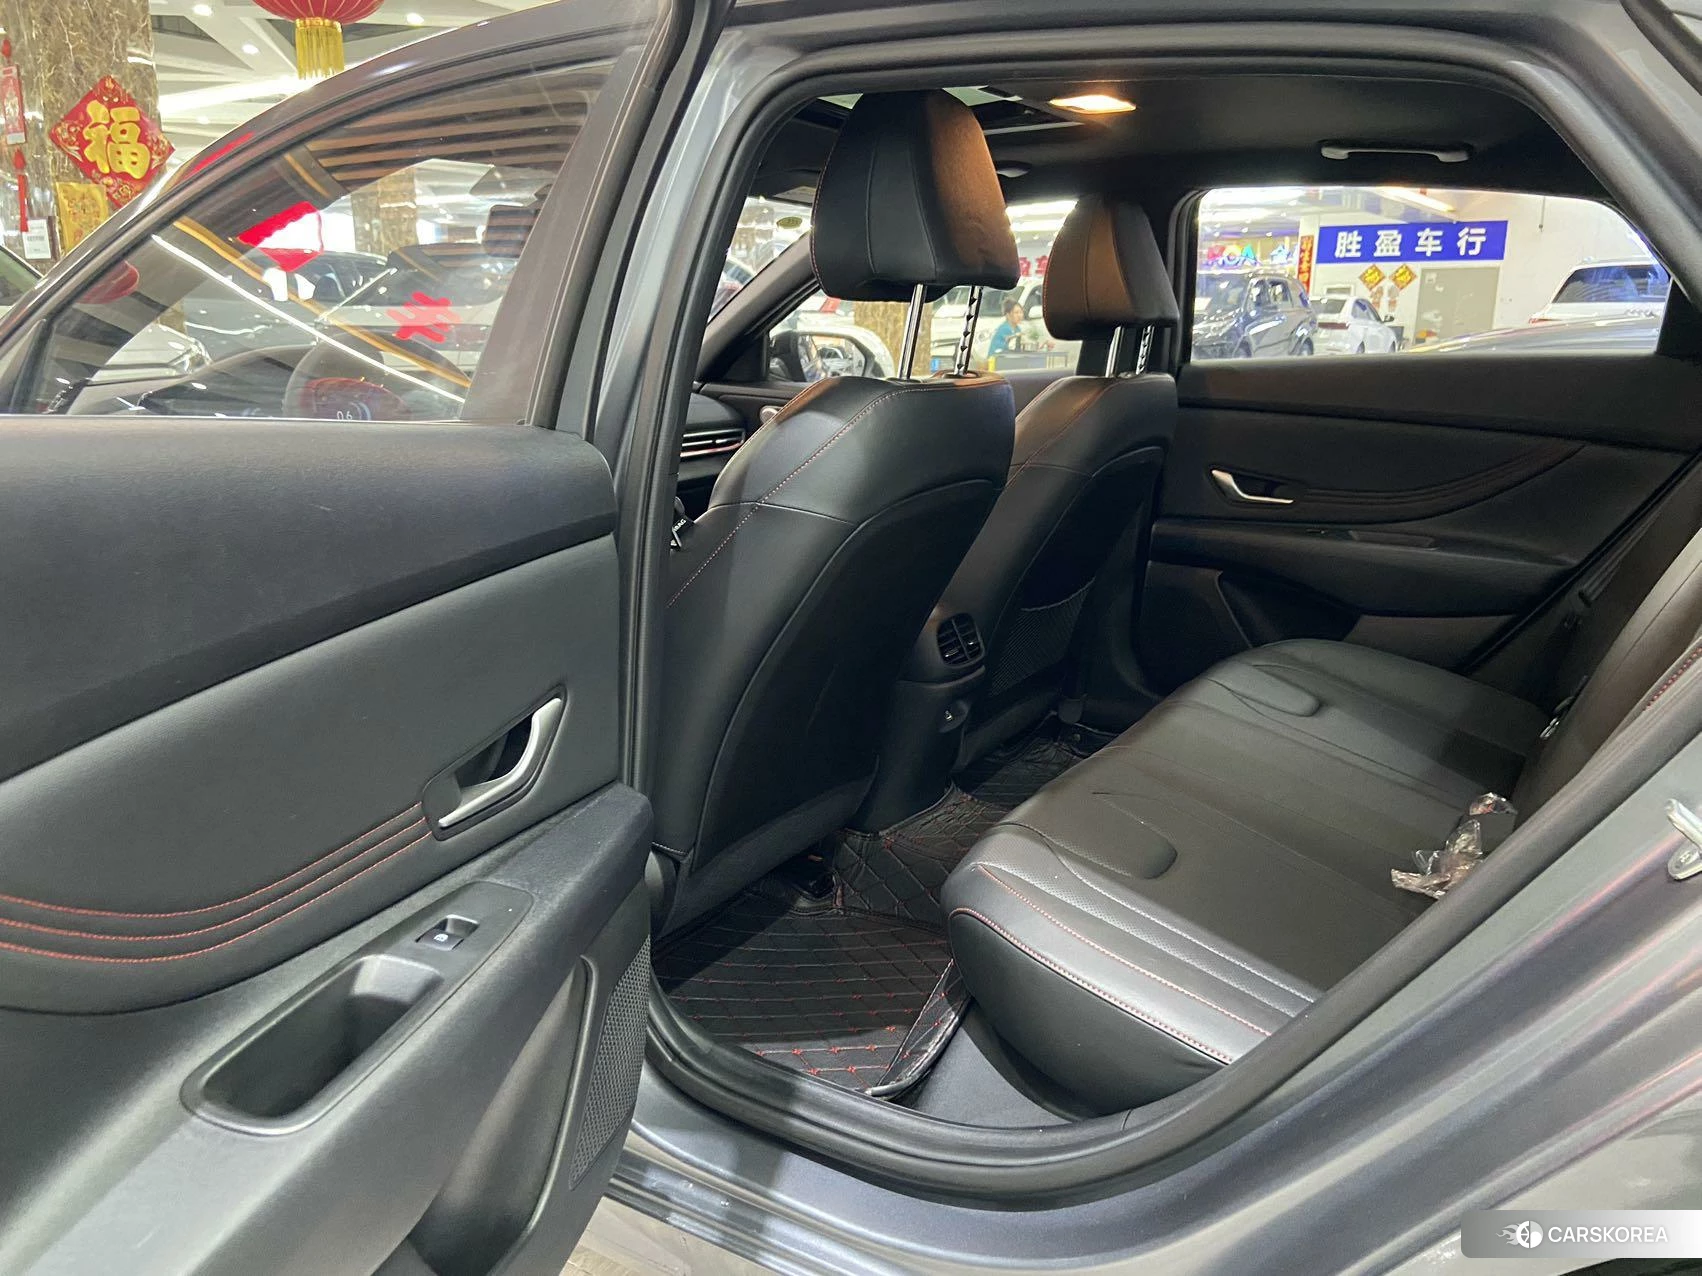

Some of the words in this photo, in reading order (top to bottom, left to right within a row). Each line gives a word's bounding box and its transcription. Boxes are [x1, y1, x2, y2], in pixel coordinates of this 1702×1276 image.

[83, 100, 151, 180] 福
[1334, 226, 1487, 259] 胜盈车行
